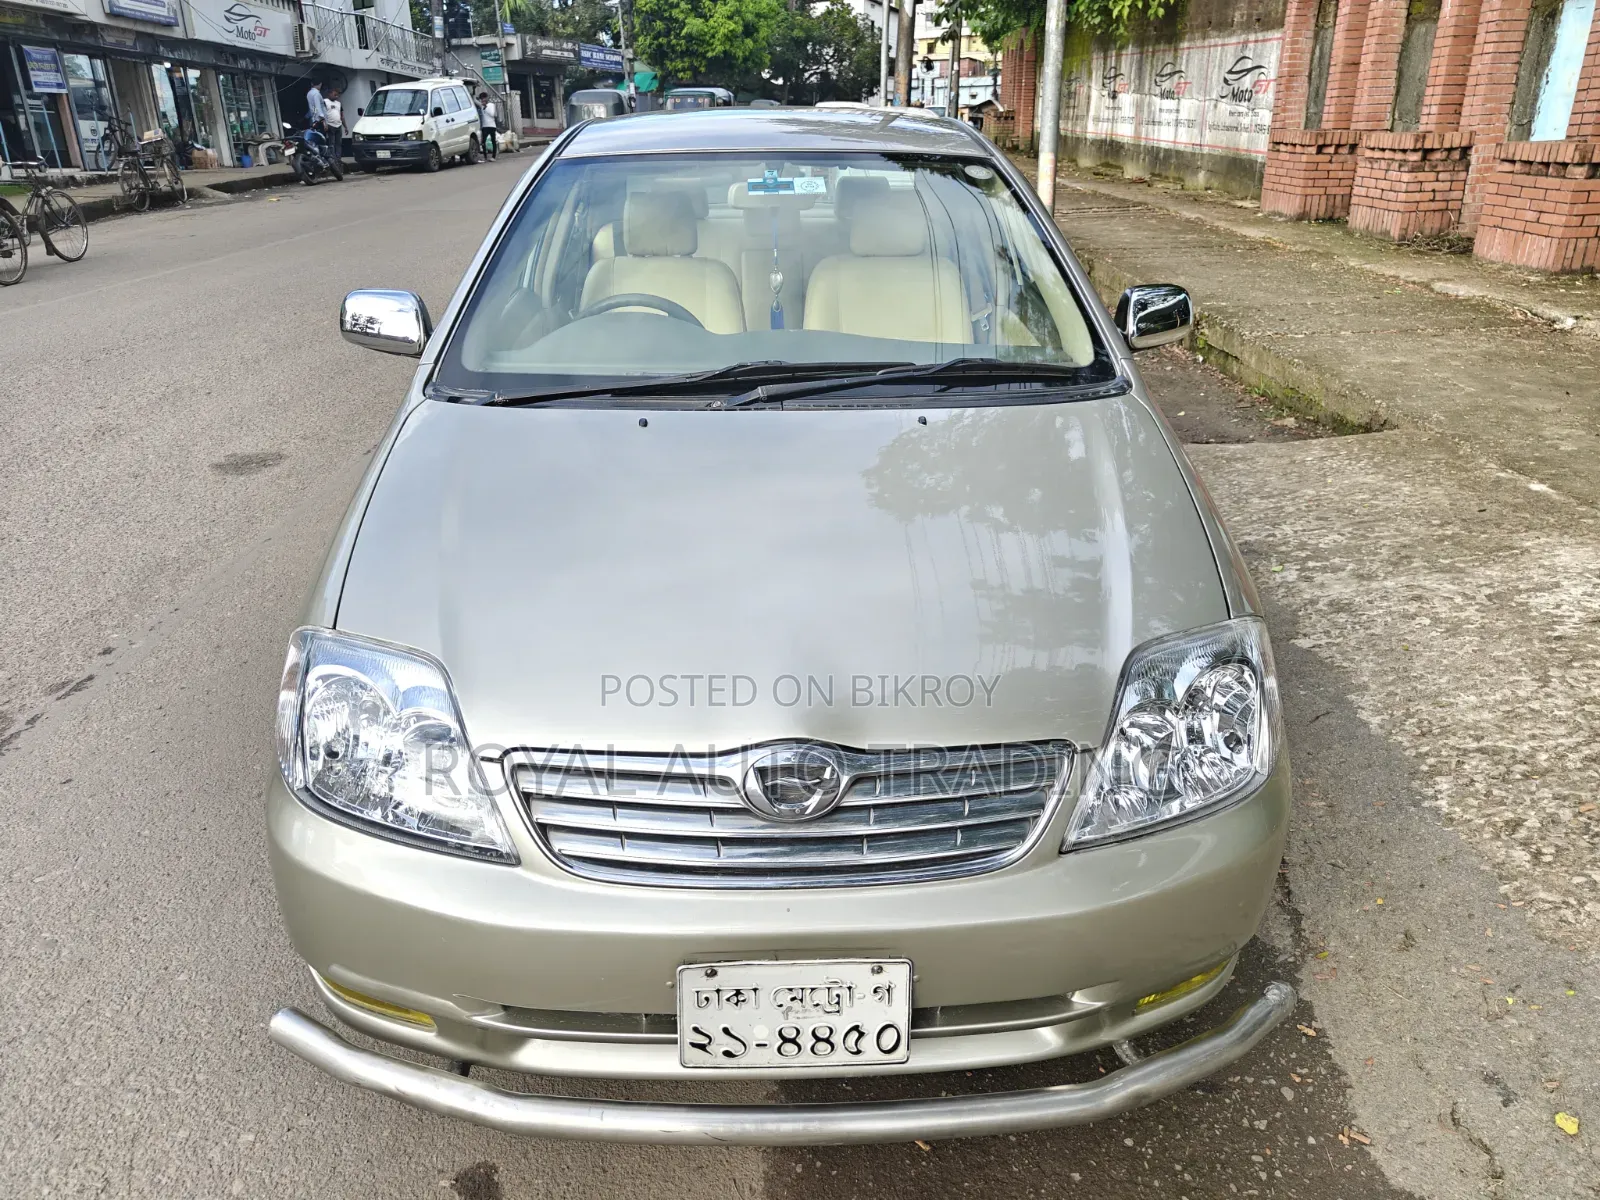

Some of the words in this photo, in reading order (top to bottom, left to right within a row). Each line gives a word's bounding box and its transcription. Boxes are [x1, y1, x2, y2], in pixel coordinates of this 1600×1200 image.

[236, 25, 256, 40] Moto
[1160, 87, 1175, 100] Moto
[1230, 86, 1253, 103] Moto
[692, 983, 761, 1010] ঢাকা
[687, 1022, 902, 1059] ২১-৪৪৫০
